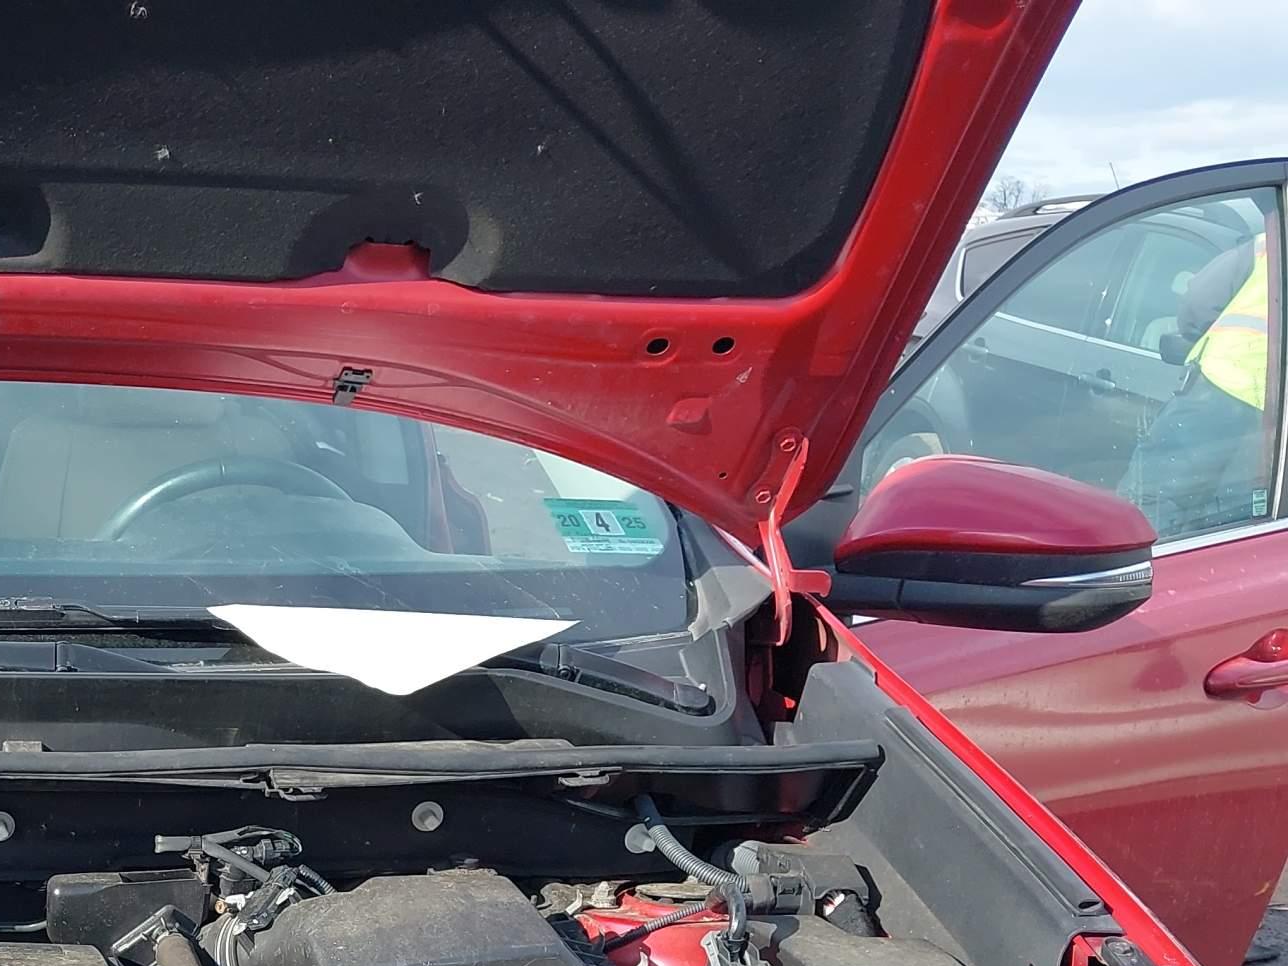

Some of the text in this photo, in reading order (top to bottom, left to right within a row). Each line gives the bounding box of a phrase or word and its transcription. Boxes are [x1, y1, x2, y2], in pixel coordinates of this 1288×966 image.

[556, 511, 648, 532] 20 4 25
